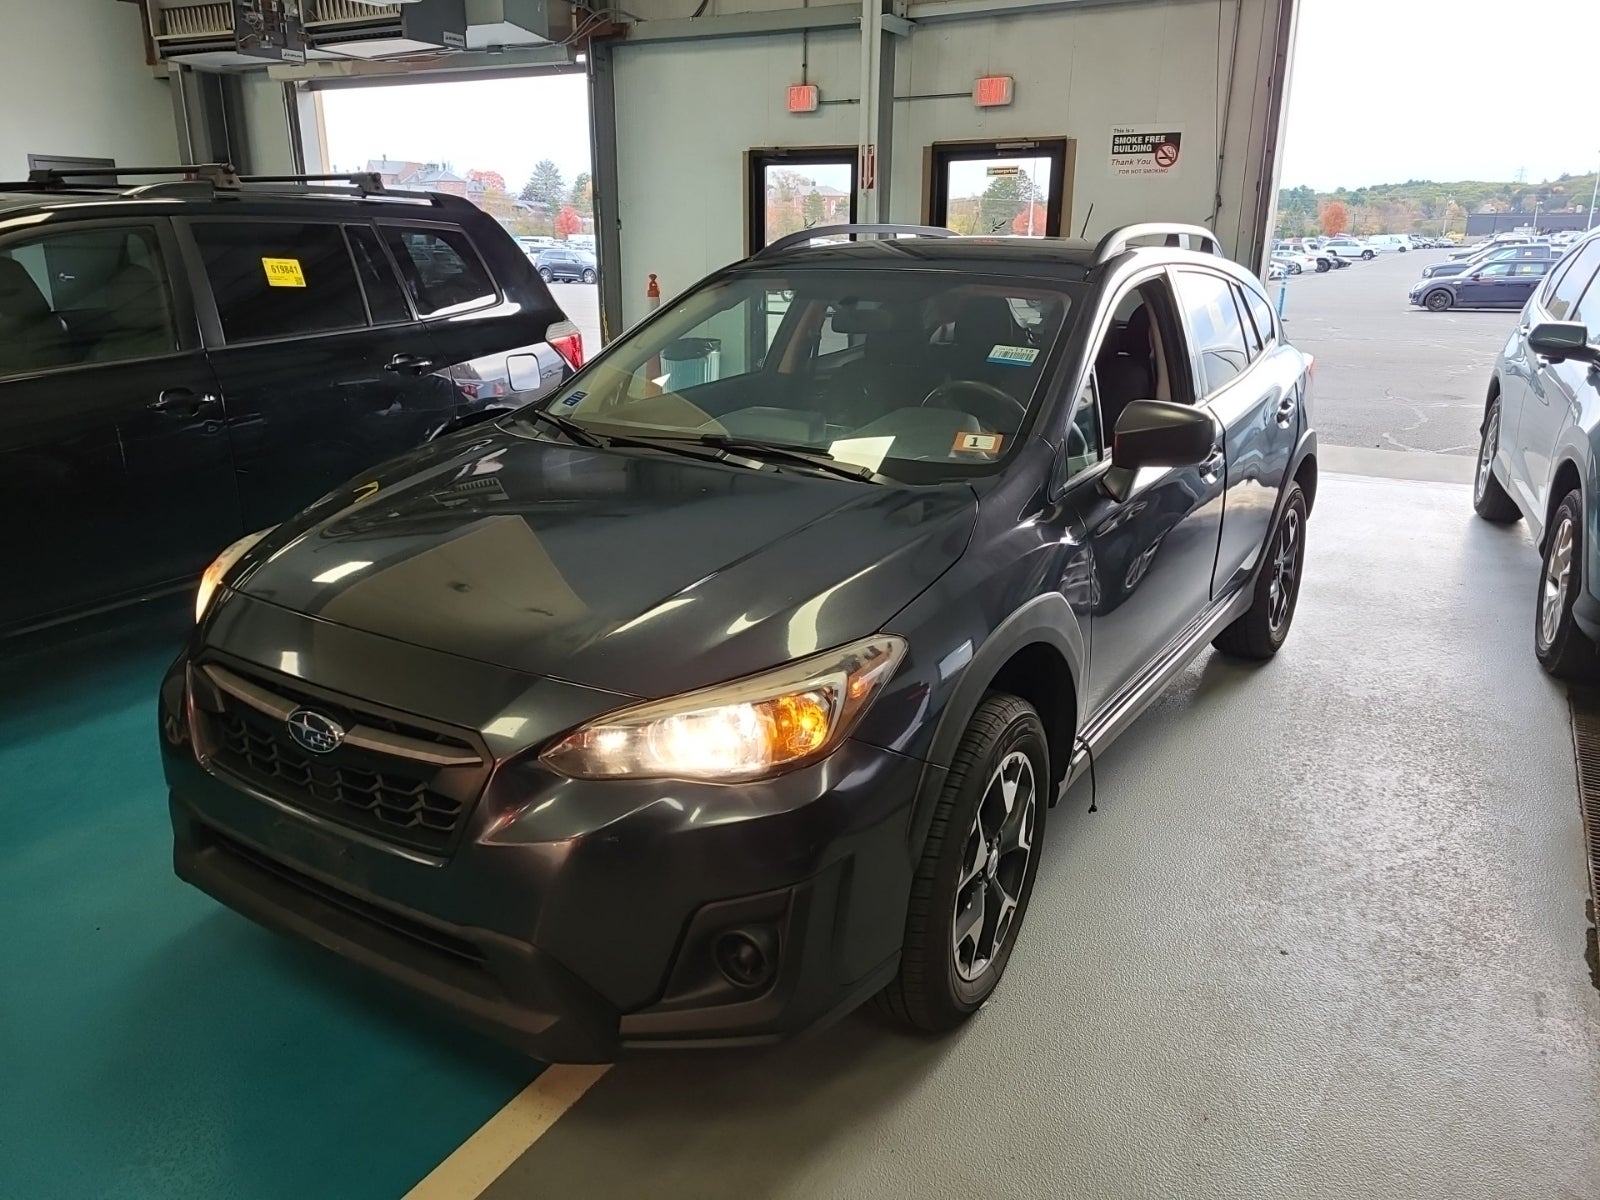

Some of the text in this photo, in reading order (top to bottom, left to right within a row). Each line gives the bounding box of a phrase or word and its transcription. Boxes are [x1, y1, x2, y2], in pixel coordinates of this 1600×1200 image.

[1114, 135, 1166, 145] SMOKE FREE
[1113, 144, 1152, 153] BUILDING
[1111, 158, 1134, 166] Thank
[969, 437, 979, 447] 1
